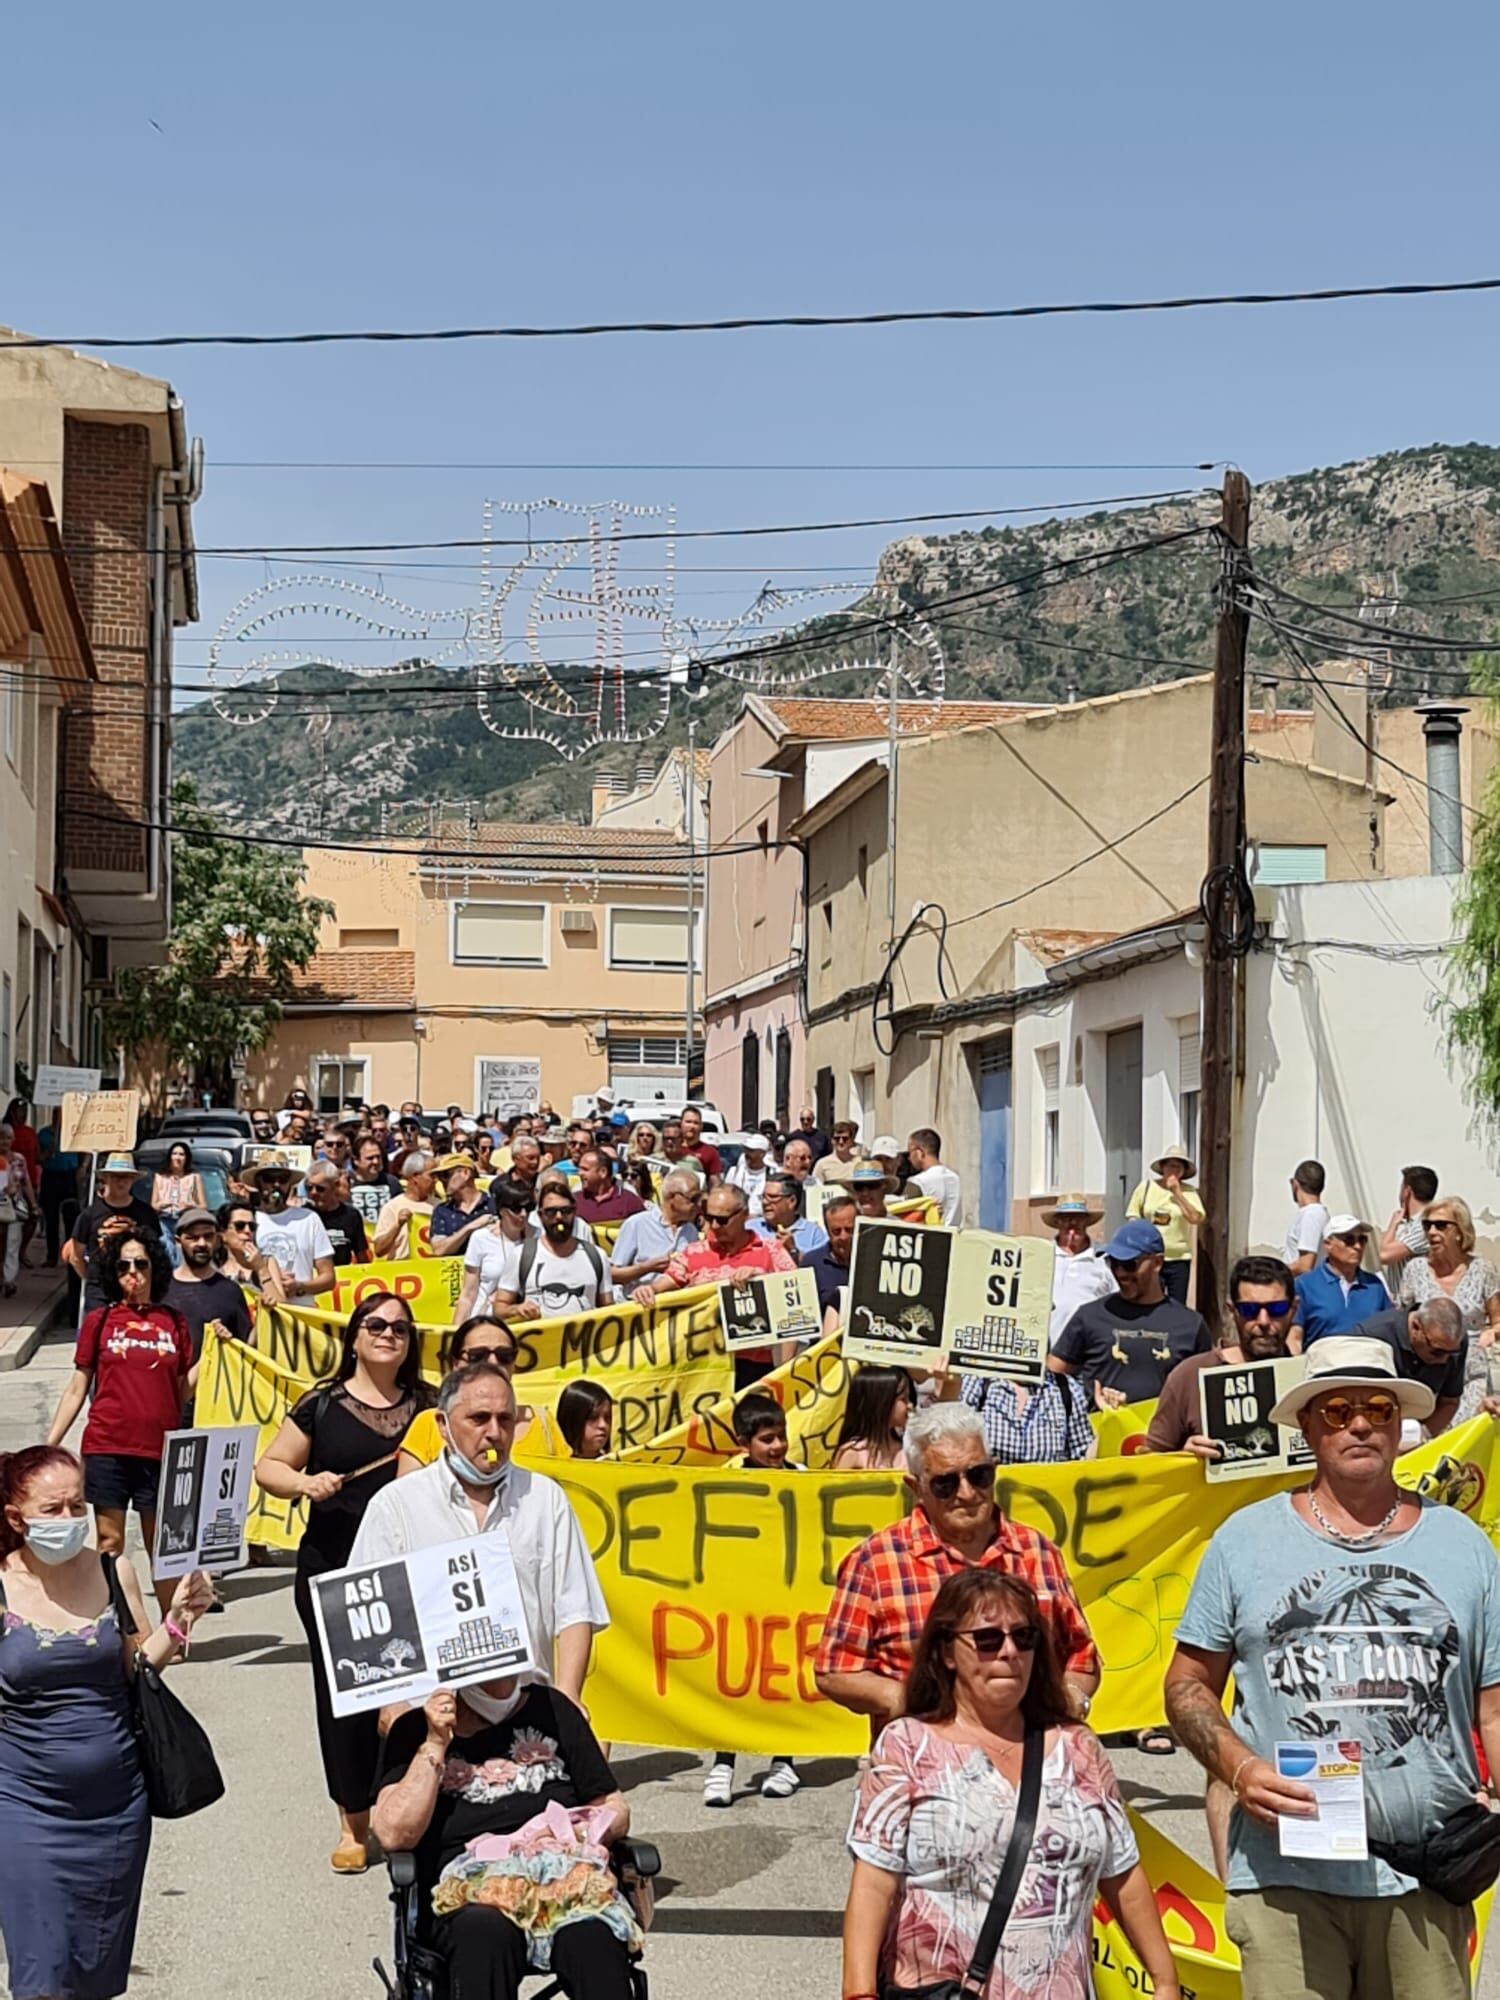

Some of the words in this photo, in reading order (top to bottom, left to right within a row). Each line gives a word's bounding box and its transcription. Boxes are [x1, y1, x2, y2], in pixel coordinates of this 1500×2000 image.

[882, 1232, 925, 1260] ASÍ
[990, 1247, 1023, 1269] ASÍ
[318, 1275, 422, 1313] TOP
[878, 1259, 923, 1297] NO
[986, 1271, 1023, 1308] SÍ
[734, 1297, 757, 1317] NO
[1223, 1371, 1255, 1397] ASÍ
[1224, 1395, 1259, 1427] NO
[176, 1440, 197, 1469] ASÍ
[223, 1440, 241, 1461] ASÍ
[173, 1472, 193, 1507] NO
[218, 1462, 238, 1500] SÍ
[551, 1473, 1138, 1589] DEFIEDE
[447, 1549, 478, 1576] ASÍ
[344, 1570, 384, 1606] ASÍ
[452, 1571, 486, 1613] SÍ
[347, 1600, 393, 1641] NO
[652, 1601, 829, 1704] PUEB
[1262, 1644, 1351, 1689] EAST
